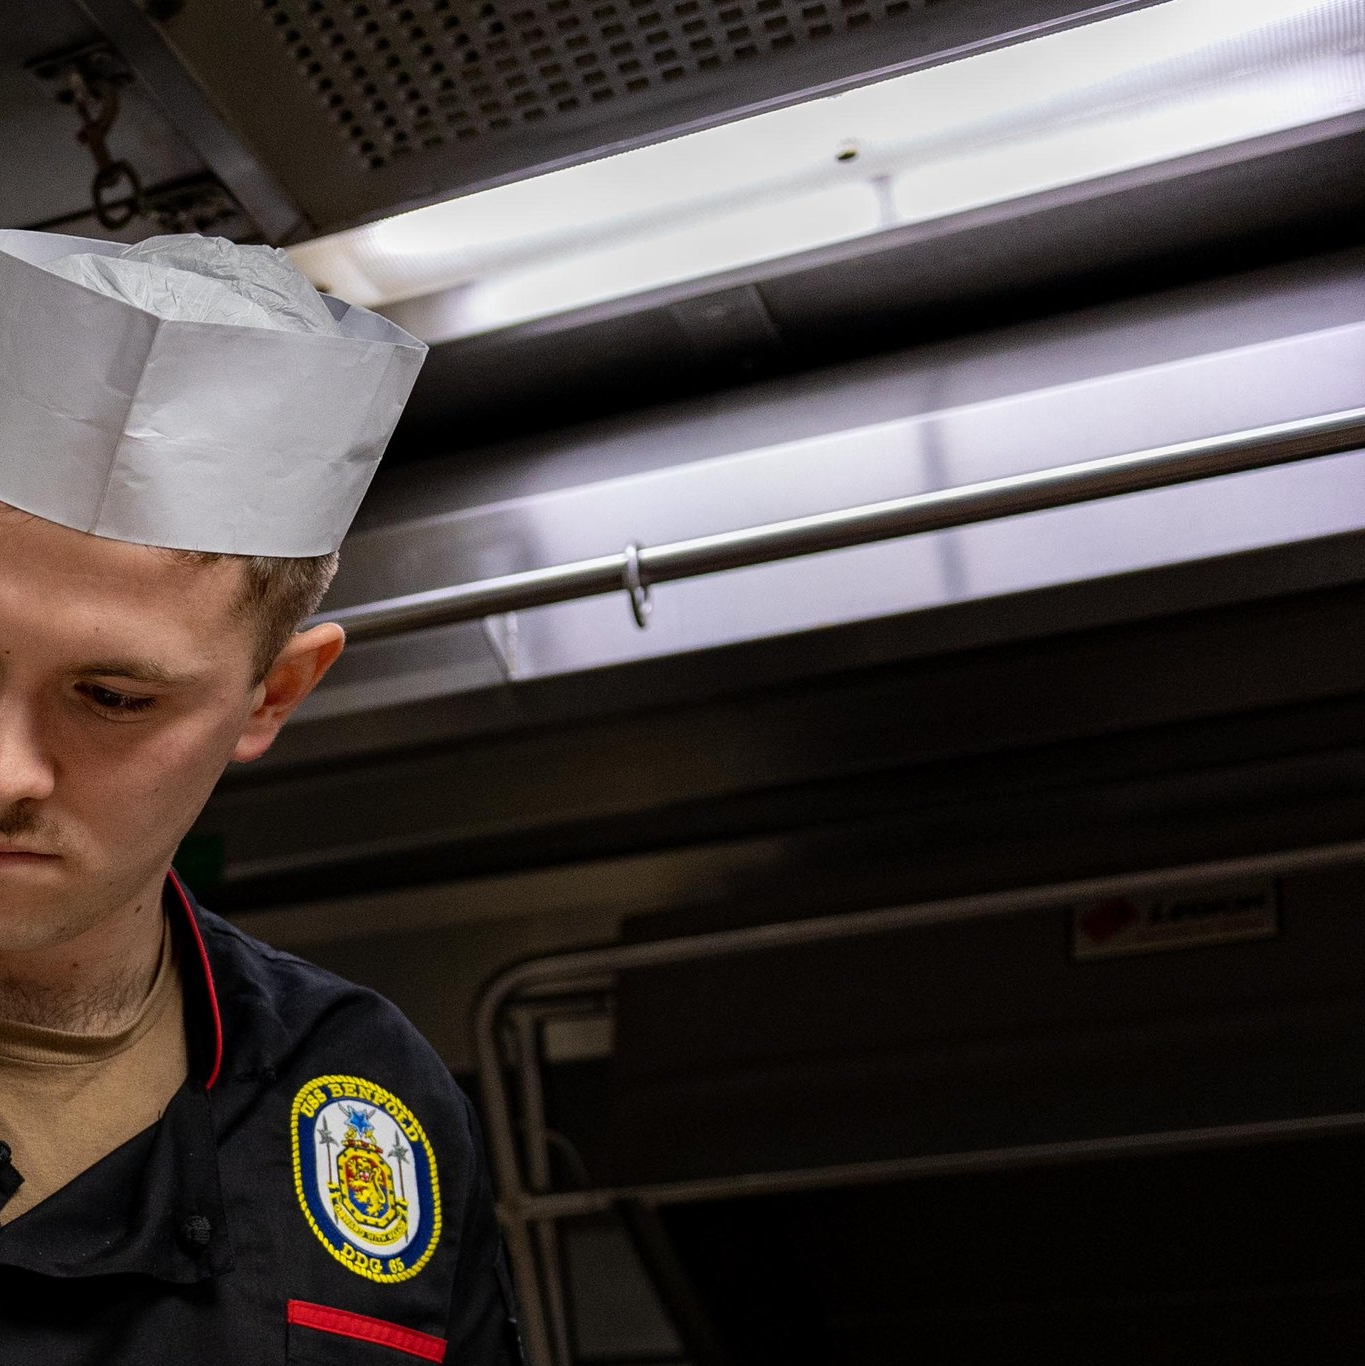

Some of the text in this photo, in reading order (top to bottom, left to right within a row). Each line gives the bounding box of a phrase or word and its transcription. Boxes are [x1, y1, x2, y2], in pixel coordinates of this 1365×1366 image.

[300, 1082, 419, 1142] USS BENFOLD
[340, 1242, 405, 1274] DDG 65
